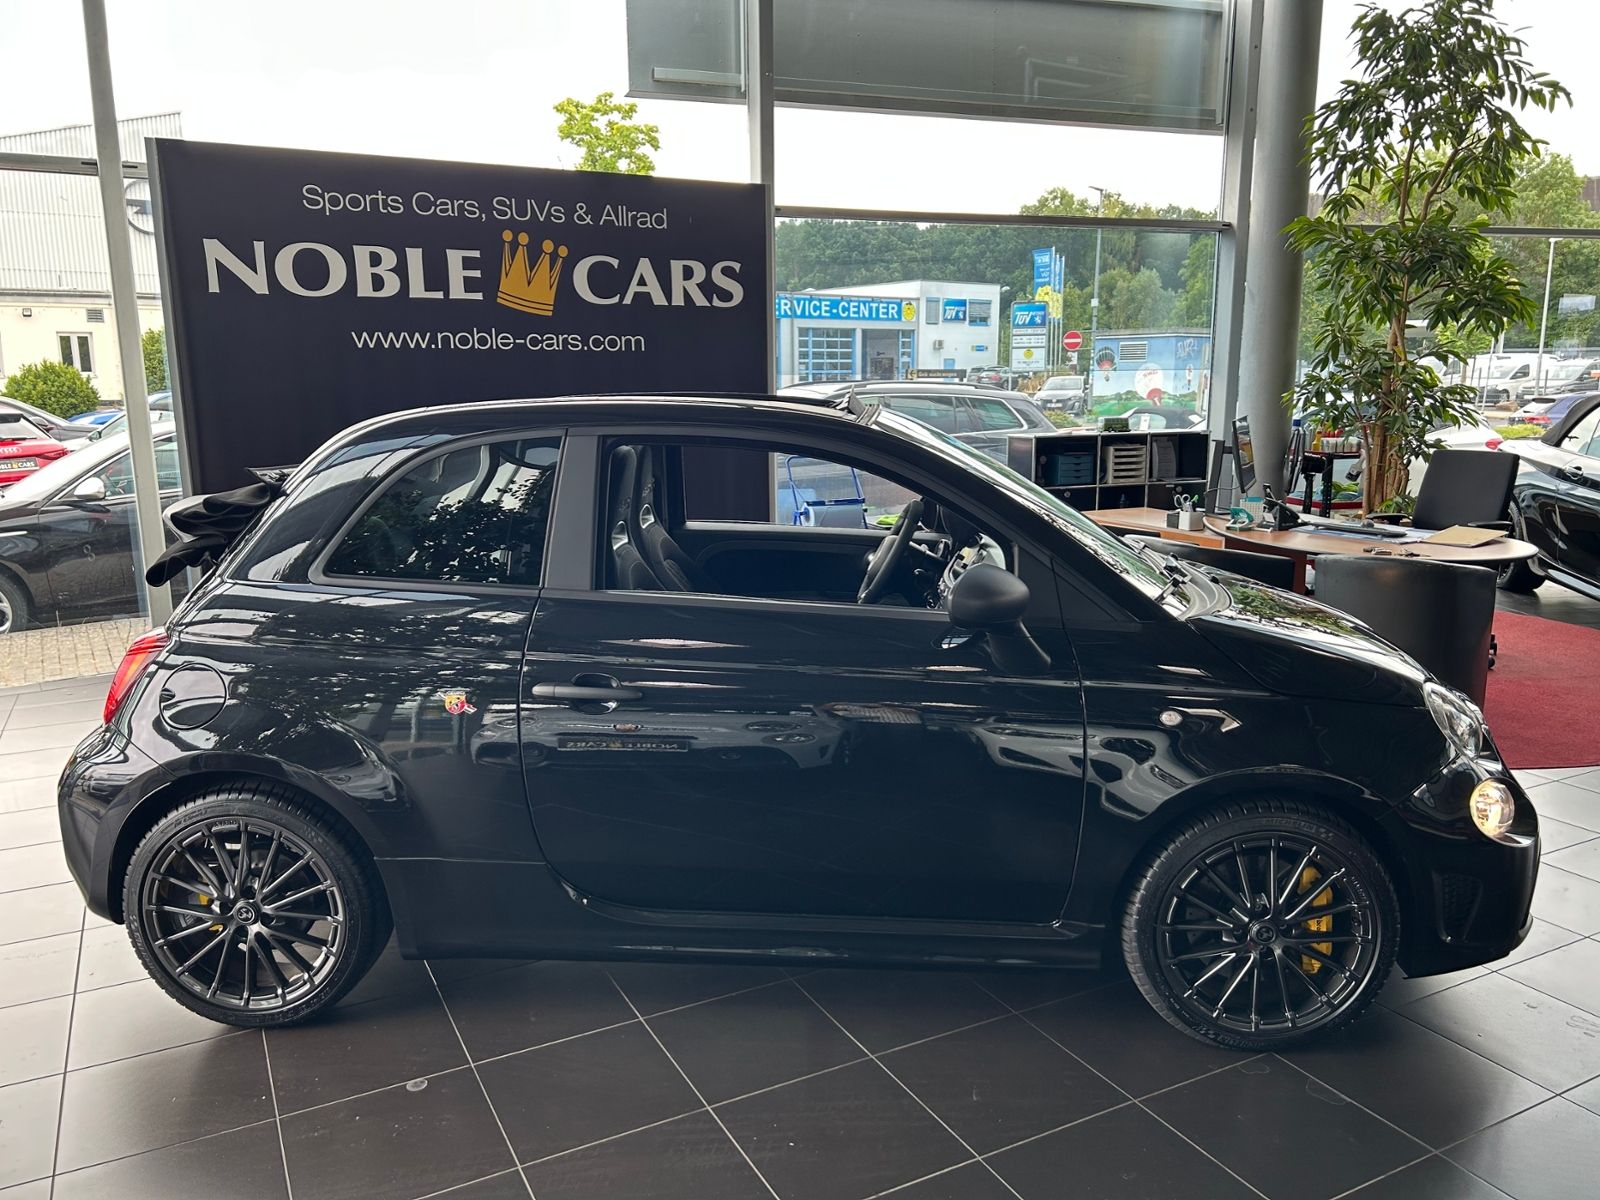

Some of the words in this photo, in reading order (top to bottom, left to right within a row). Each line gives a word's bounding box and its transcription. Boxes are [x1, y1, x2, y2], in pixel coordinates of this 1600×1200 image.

[302, 184, 404, 216] Sports
[412, 191, 487, 222] Cars,
[492, 196, 566, 223] SUVs
[573, 202, 594, 225] &
[599, 204, 669, 230] Allrad
[202, 238, 484, 301] NOBLE
[572, 254, 745, 308] CARS
[351, 327, 646, 353] www.noble-cars.com
